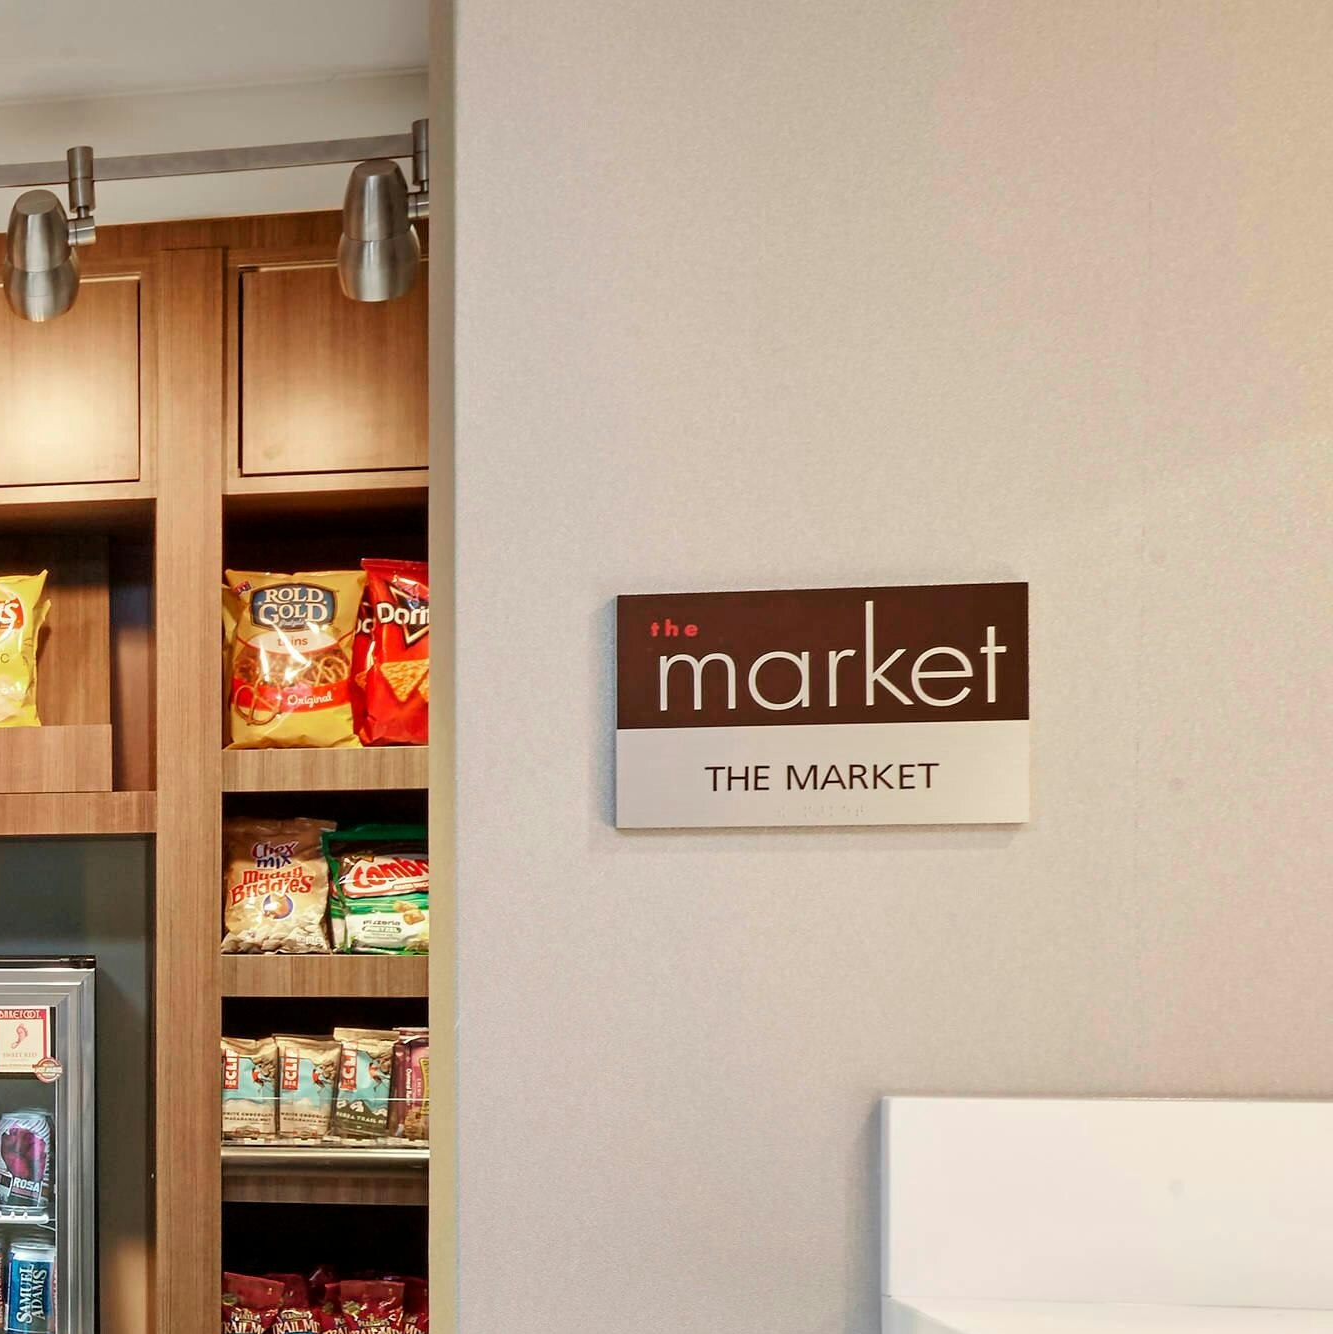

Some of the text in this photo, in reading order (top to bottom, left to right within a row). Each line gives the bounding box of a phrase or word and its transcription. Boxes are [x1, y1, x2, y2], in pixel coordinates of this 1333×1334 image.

[263, 587, 324, 603] ROLD
[258, 601, 329, 625] GOLD
[649, 618, 700, 638] the
[276, 636, 309, 647] tins
[658, 600, 1008, 712] market
[287, 690, 333, 708] Original
[704, 762, 941, 792] THE MARKET
[252, 841, 299, 858] Chex
[256, 855, 293, 870] mix
[242, 865, 303, 884] Muddy
[230, 875, 315, 907] Buddies
[12, 1177, 41, 1193] ROSA
[16, 1263, 35, 1325] SAMUEL
[32, 1268, 47, 1321] ADAMS
